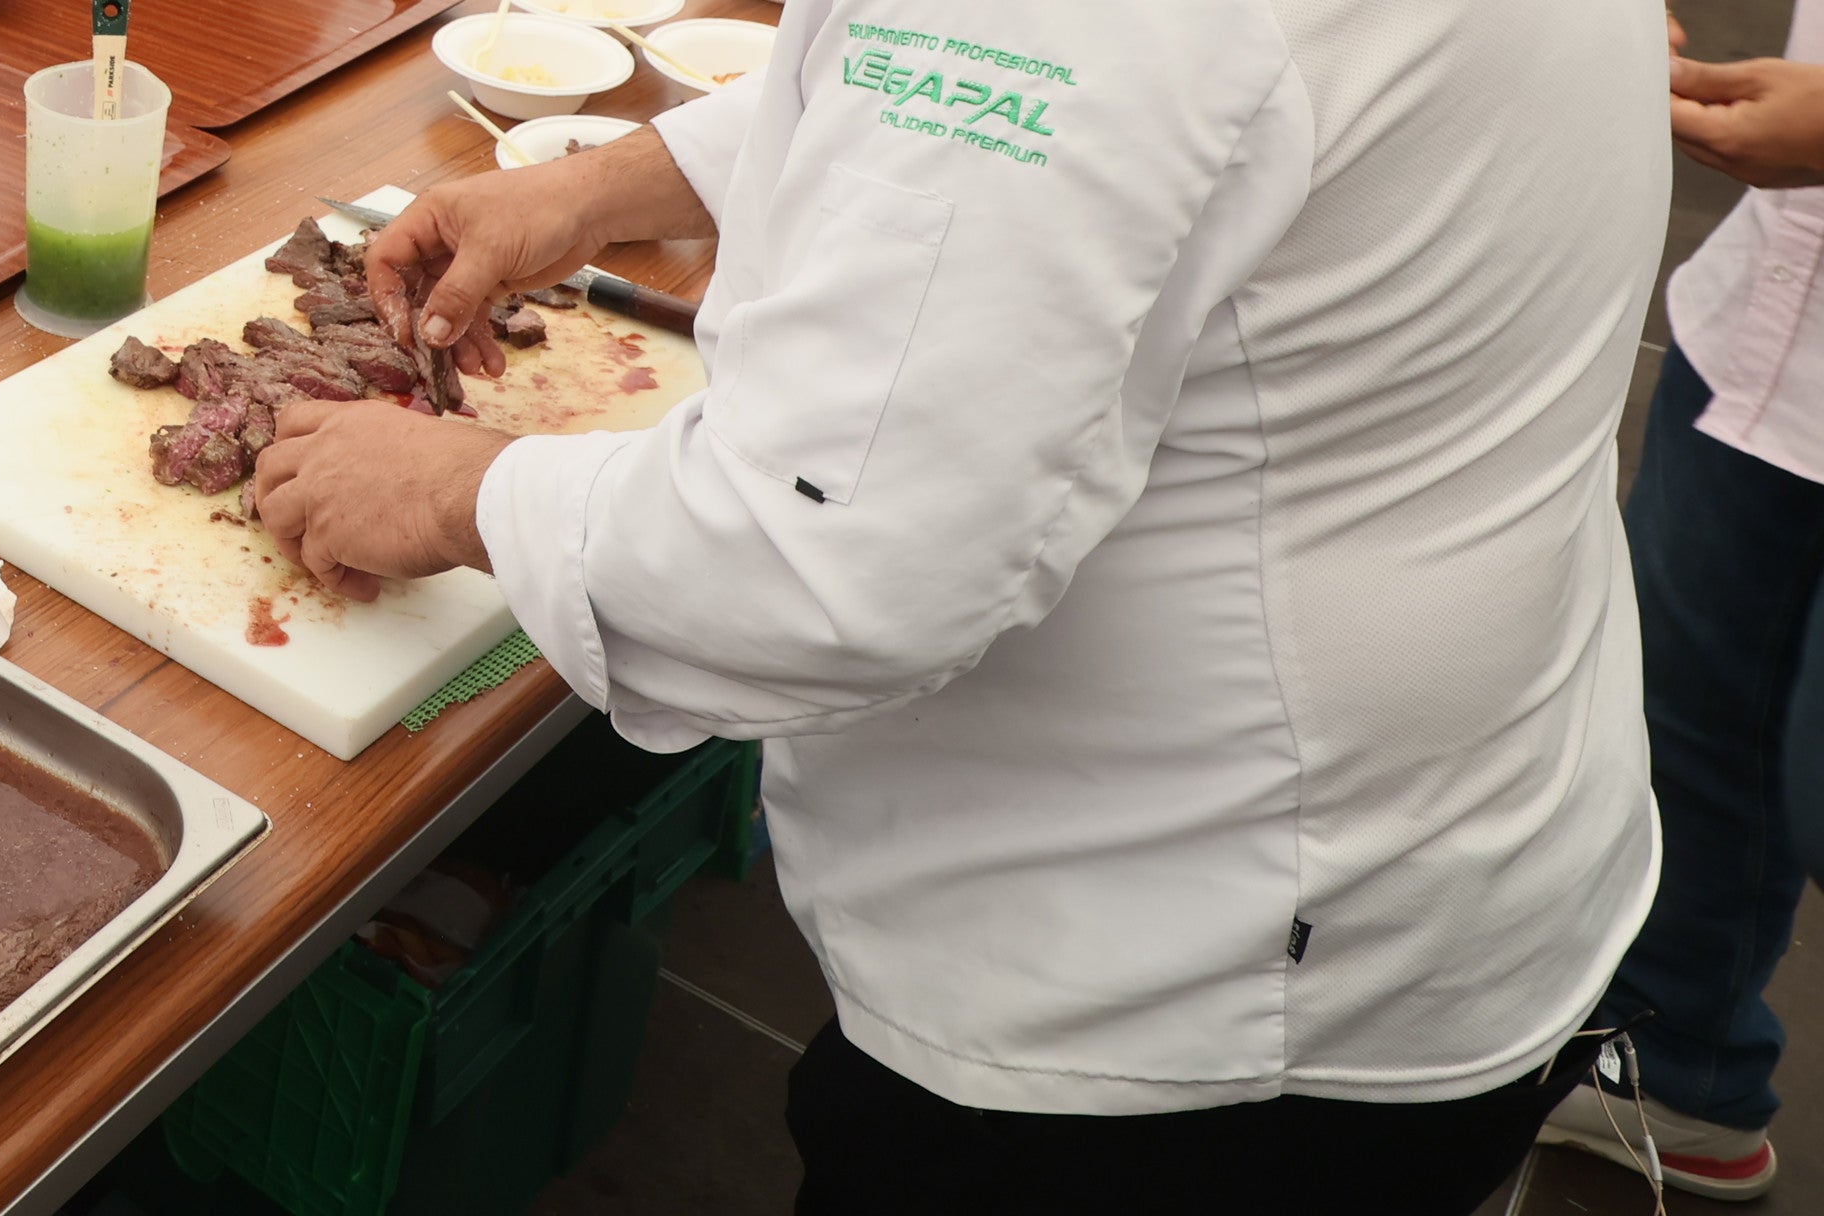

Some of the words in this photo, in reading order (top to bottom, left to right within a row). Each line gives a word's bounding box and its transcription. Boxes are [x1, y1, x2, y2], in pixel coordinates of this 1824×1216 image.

[848, 23, 940, 51] EQUIPAMIENTO
[942, 38, 1077, 86] PROFESIONAL
[843, 49, 1055, 136] VEGAPAL
[880, 110, 948, 137] CALIDAD
[951, 127, 1048, 167] PREMIUM
